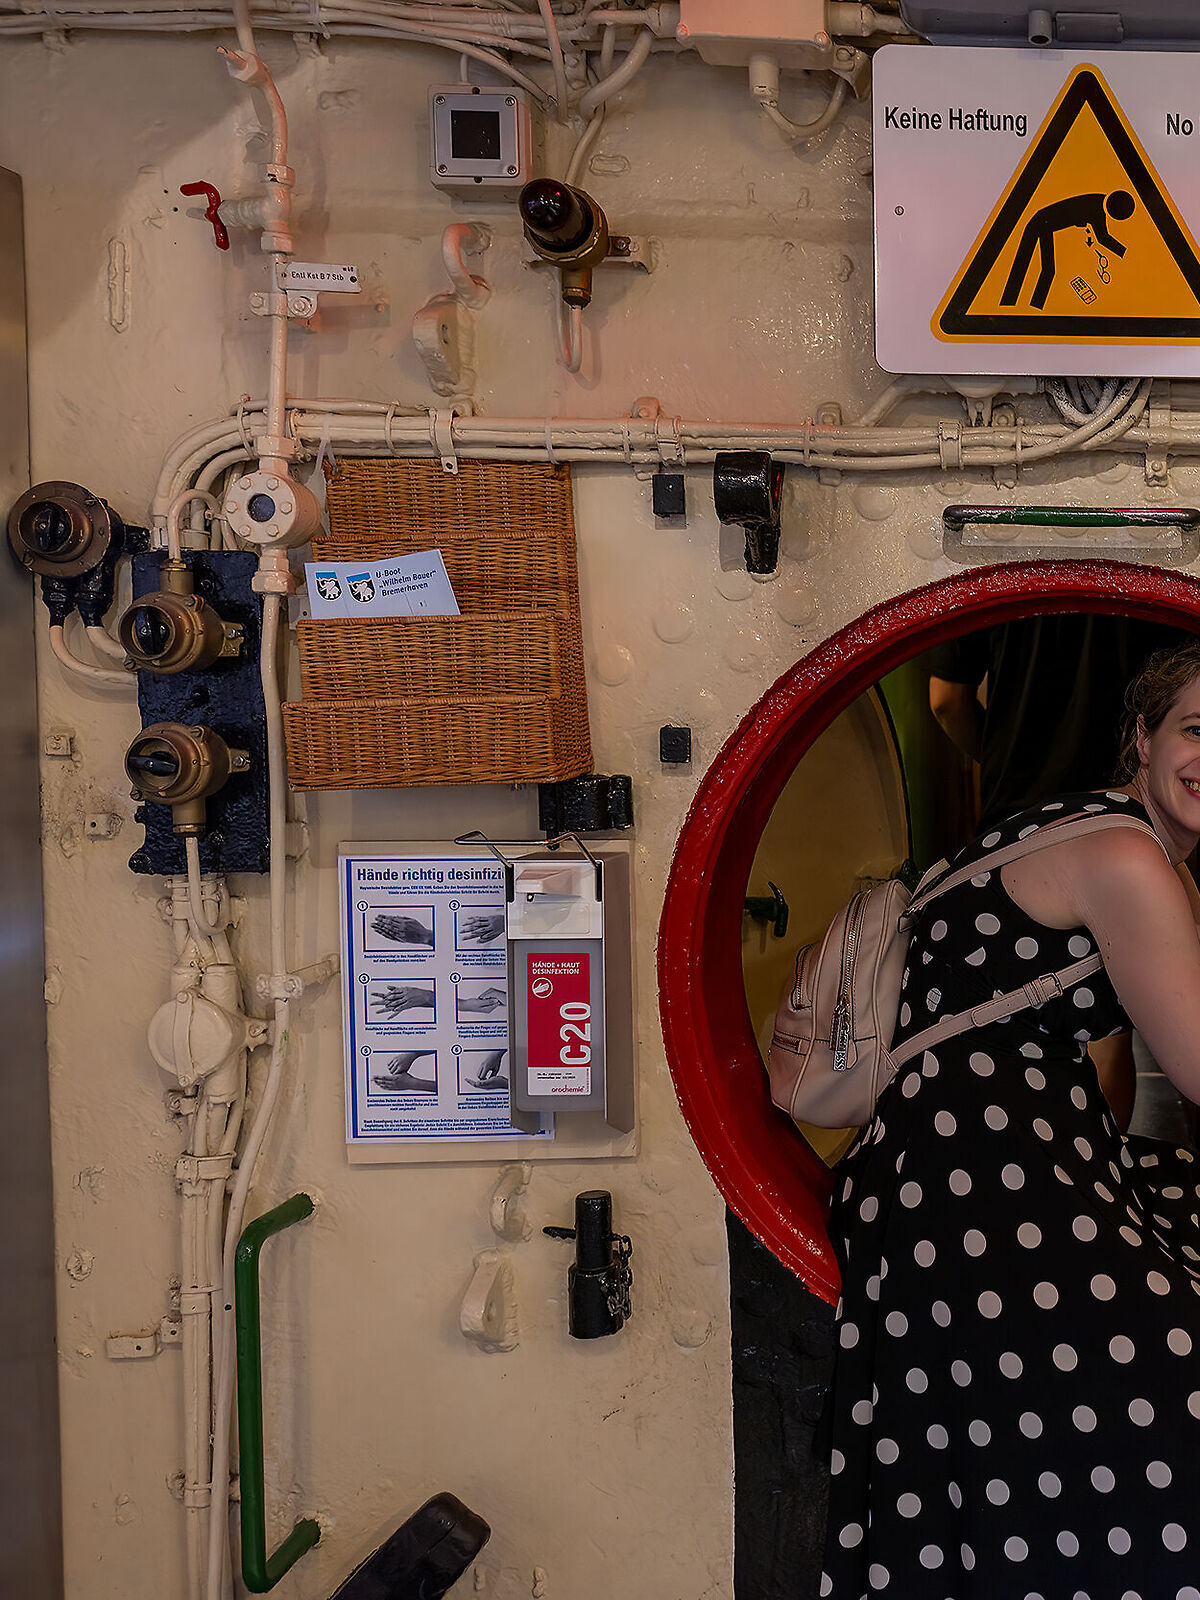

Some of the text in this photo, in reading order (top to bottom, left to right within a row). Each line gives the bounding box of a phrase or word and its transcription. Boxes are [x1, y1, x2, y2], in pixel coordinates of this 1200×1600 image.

[884, 106, 1028, 137] Keine Haftung
[1166, 113, 1194, 136] No
[375, 568, 401, 579] U-Boot
[381, 582, 429, 597] Bremerhaven
[357, 868, 399, 881] Hände
[402, 867, 444, 882] richtig
[559, 1002, 591, 1065] C20
